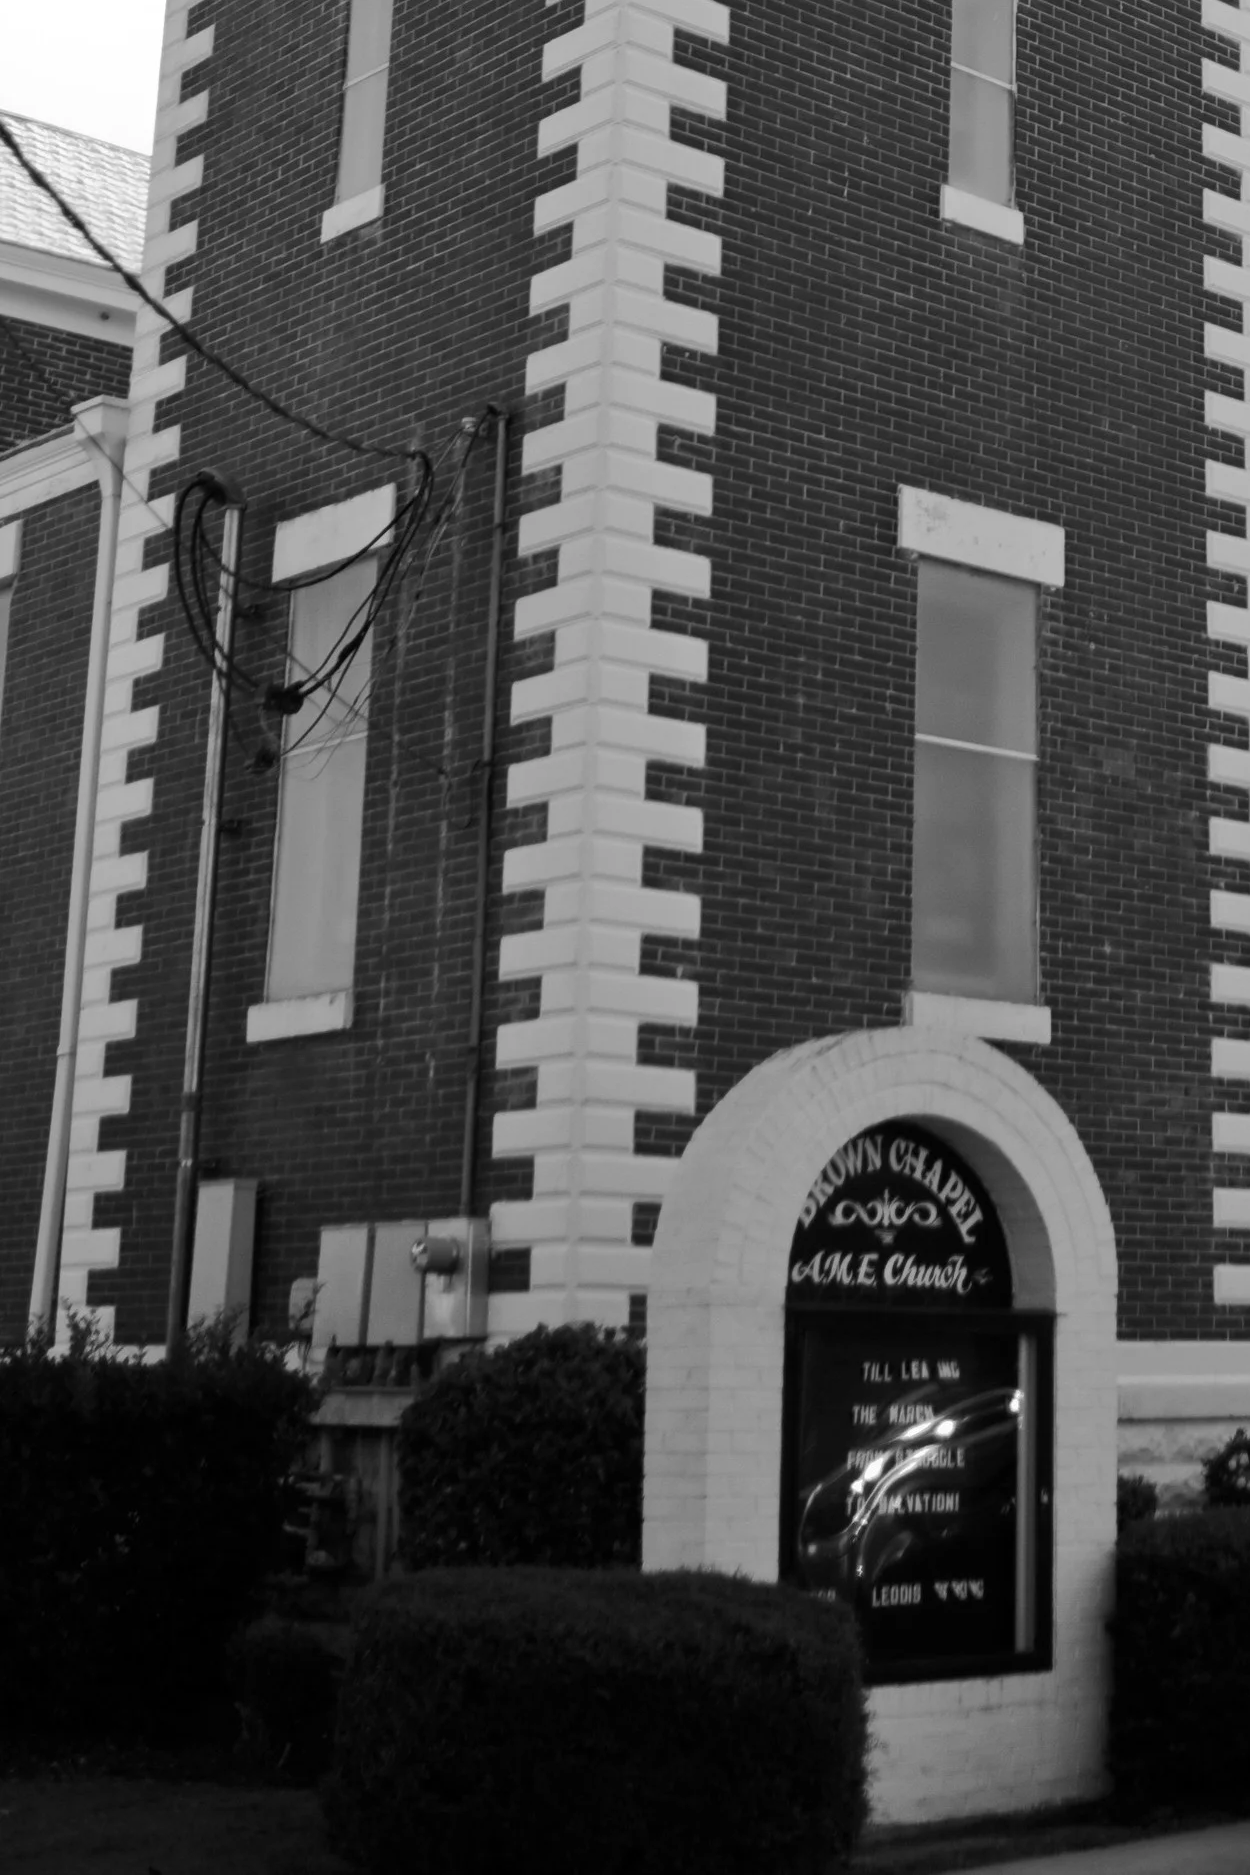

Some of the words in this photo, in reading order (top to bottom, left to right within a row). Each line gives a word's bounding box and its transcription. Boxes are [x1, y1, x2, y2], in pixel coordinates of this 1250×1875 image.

[889, 1138, 983, 1244] CHAPEL
[791, 1250, 879, 1287] A.M.E.
[883, 1254, 972, 1294] Church
[852, 1405, 878, 1424] THE
